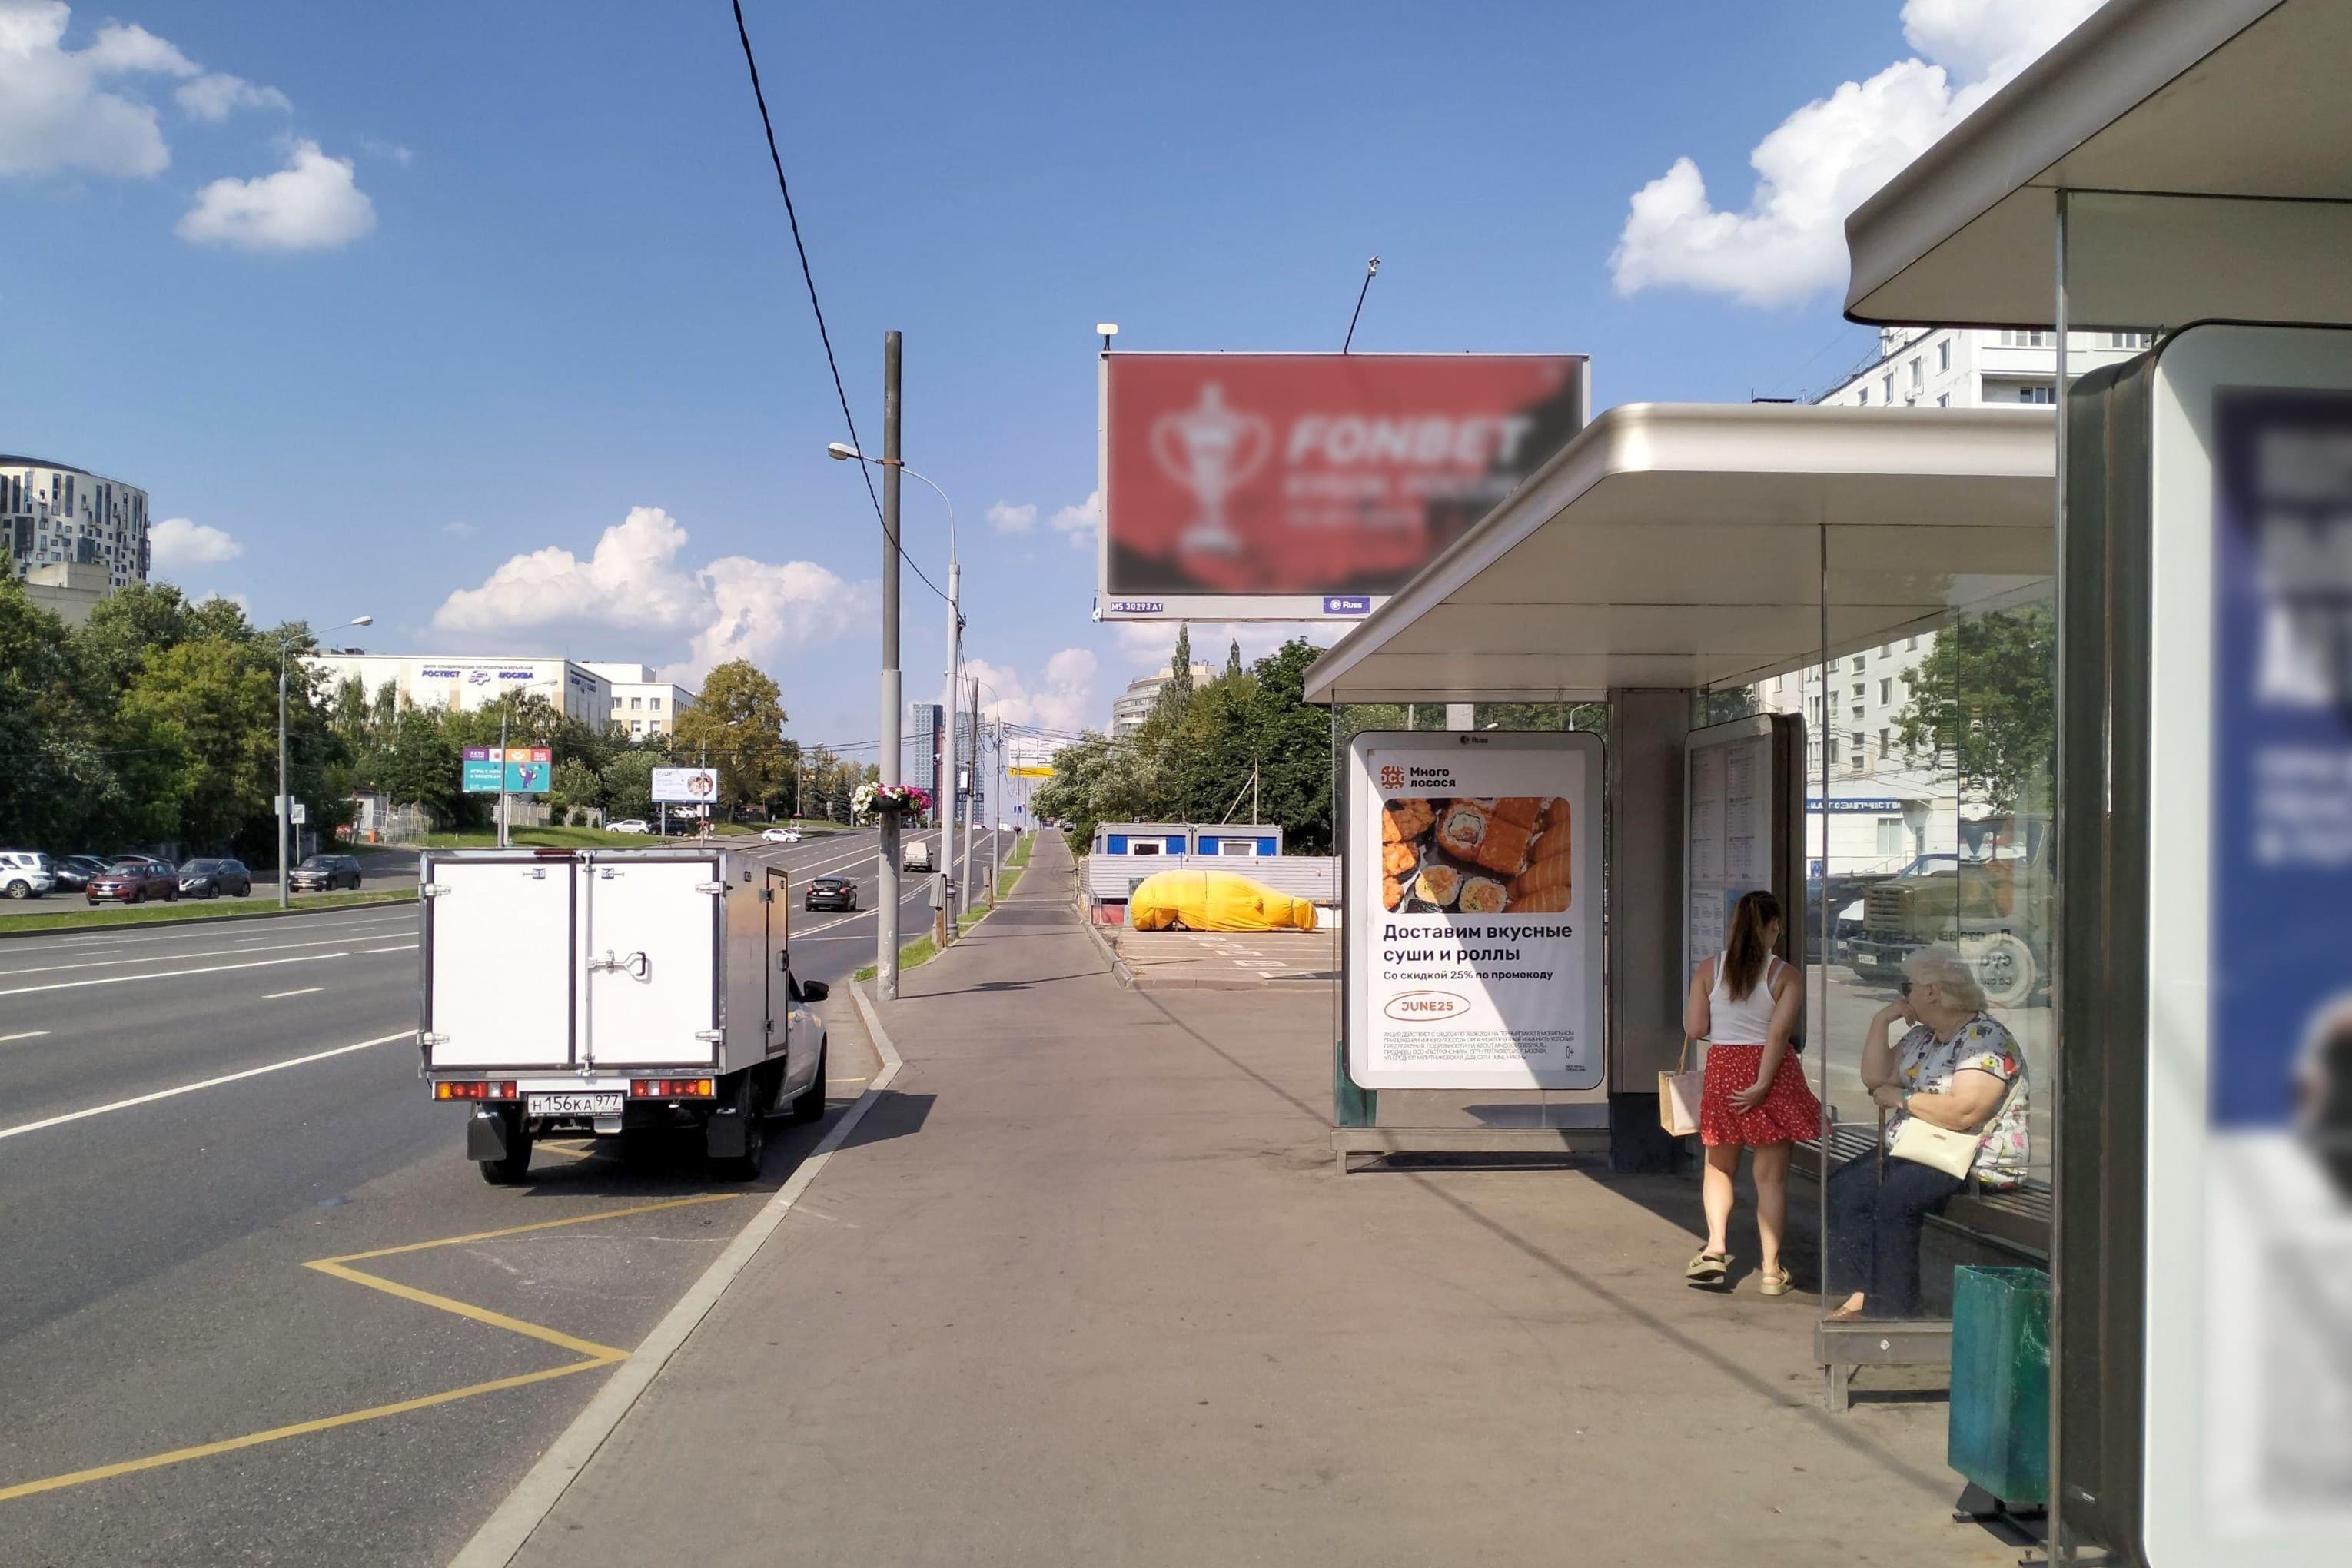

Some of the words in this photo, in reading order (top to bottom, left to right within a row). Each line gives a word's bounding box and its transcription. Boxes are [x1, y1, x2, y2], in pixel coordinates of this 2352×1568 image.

[1410, 766, 1450, 777] Много
[1410, 779, 1456, 788] лосося
[1383, 925, 1481, 942] Доставим
[1487, 925, 1573, 942] вкусные
[1384, 949, 1434, 965] суши
[1440, 950, 1450, 961] и
[1457, 948, 1520, 965] роллы
[1384, 971, 1398, 980] Со
[1400, 970, 1448, 981] скидкой
[1450, 970, 1473, 980] 25%
[1491, 972, 1553, 981] промокоду
[1401, 1001, 1453, 1011] JUNE25
[596, 1095, 619, 1106] 977
